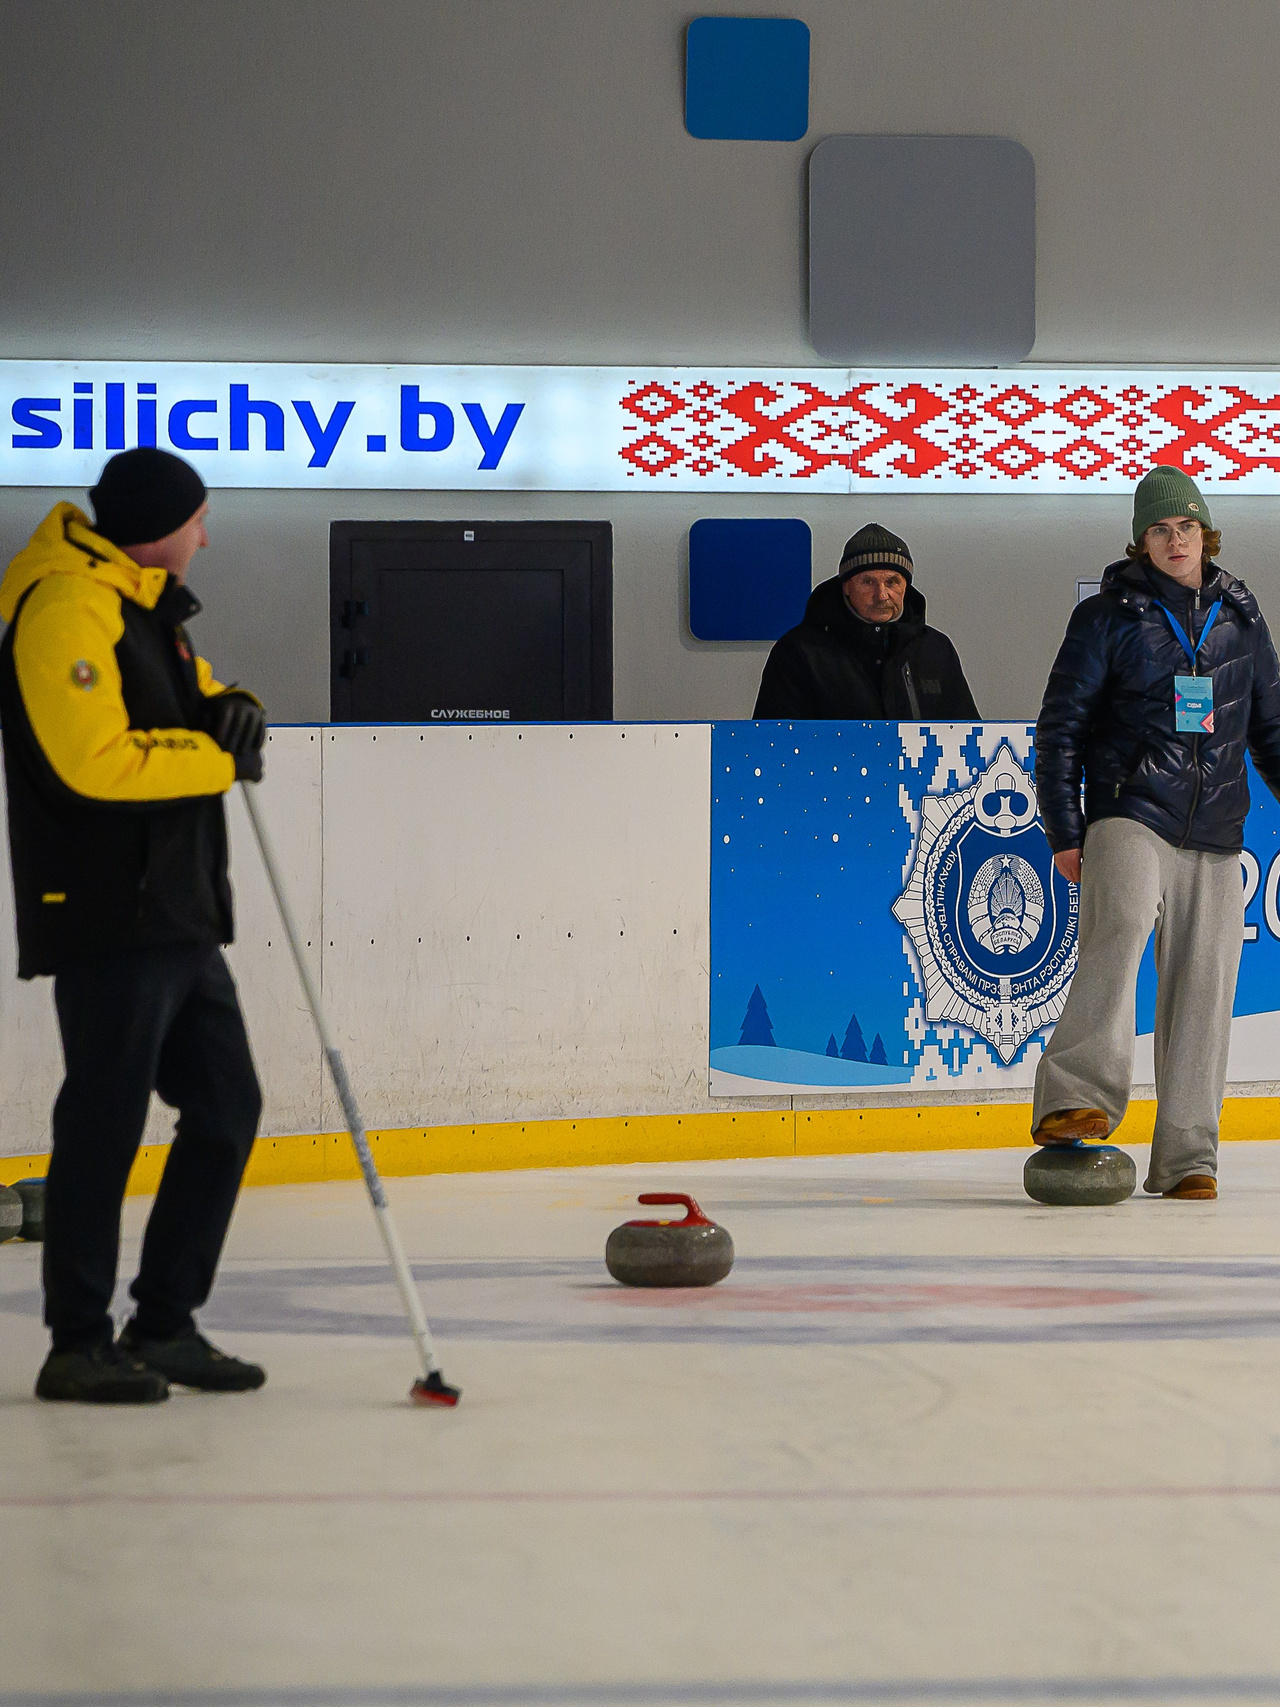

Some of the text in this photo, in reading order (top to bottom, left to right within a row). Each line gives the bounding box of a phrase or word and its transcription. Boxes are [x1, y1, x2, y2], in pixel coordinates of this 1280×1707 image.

[11, 382, 525, 469] silichy.by
[431, 709, 510, 719] СЛУЖЕБНОЕ
[943, 932, 979, 986] СПРАВАМІ
[1039, 916, 1078, 982] РЭСПУБЛІКІ
[1067, 881, 1079, 913] БЕЛА
[992, 929, 1021, 939] РЭСПУБЛІКА
[993, 937, 1020, 945] БЕЛАРУСЬ
